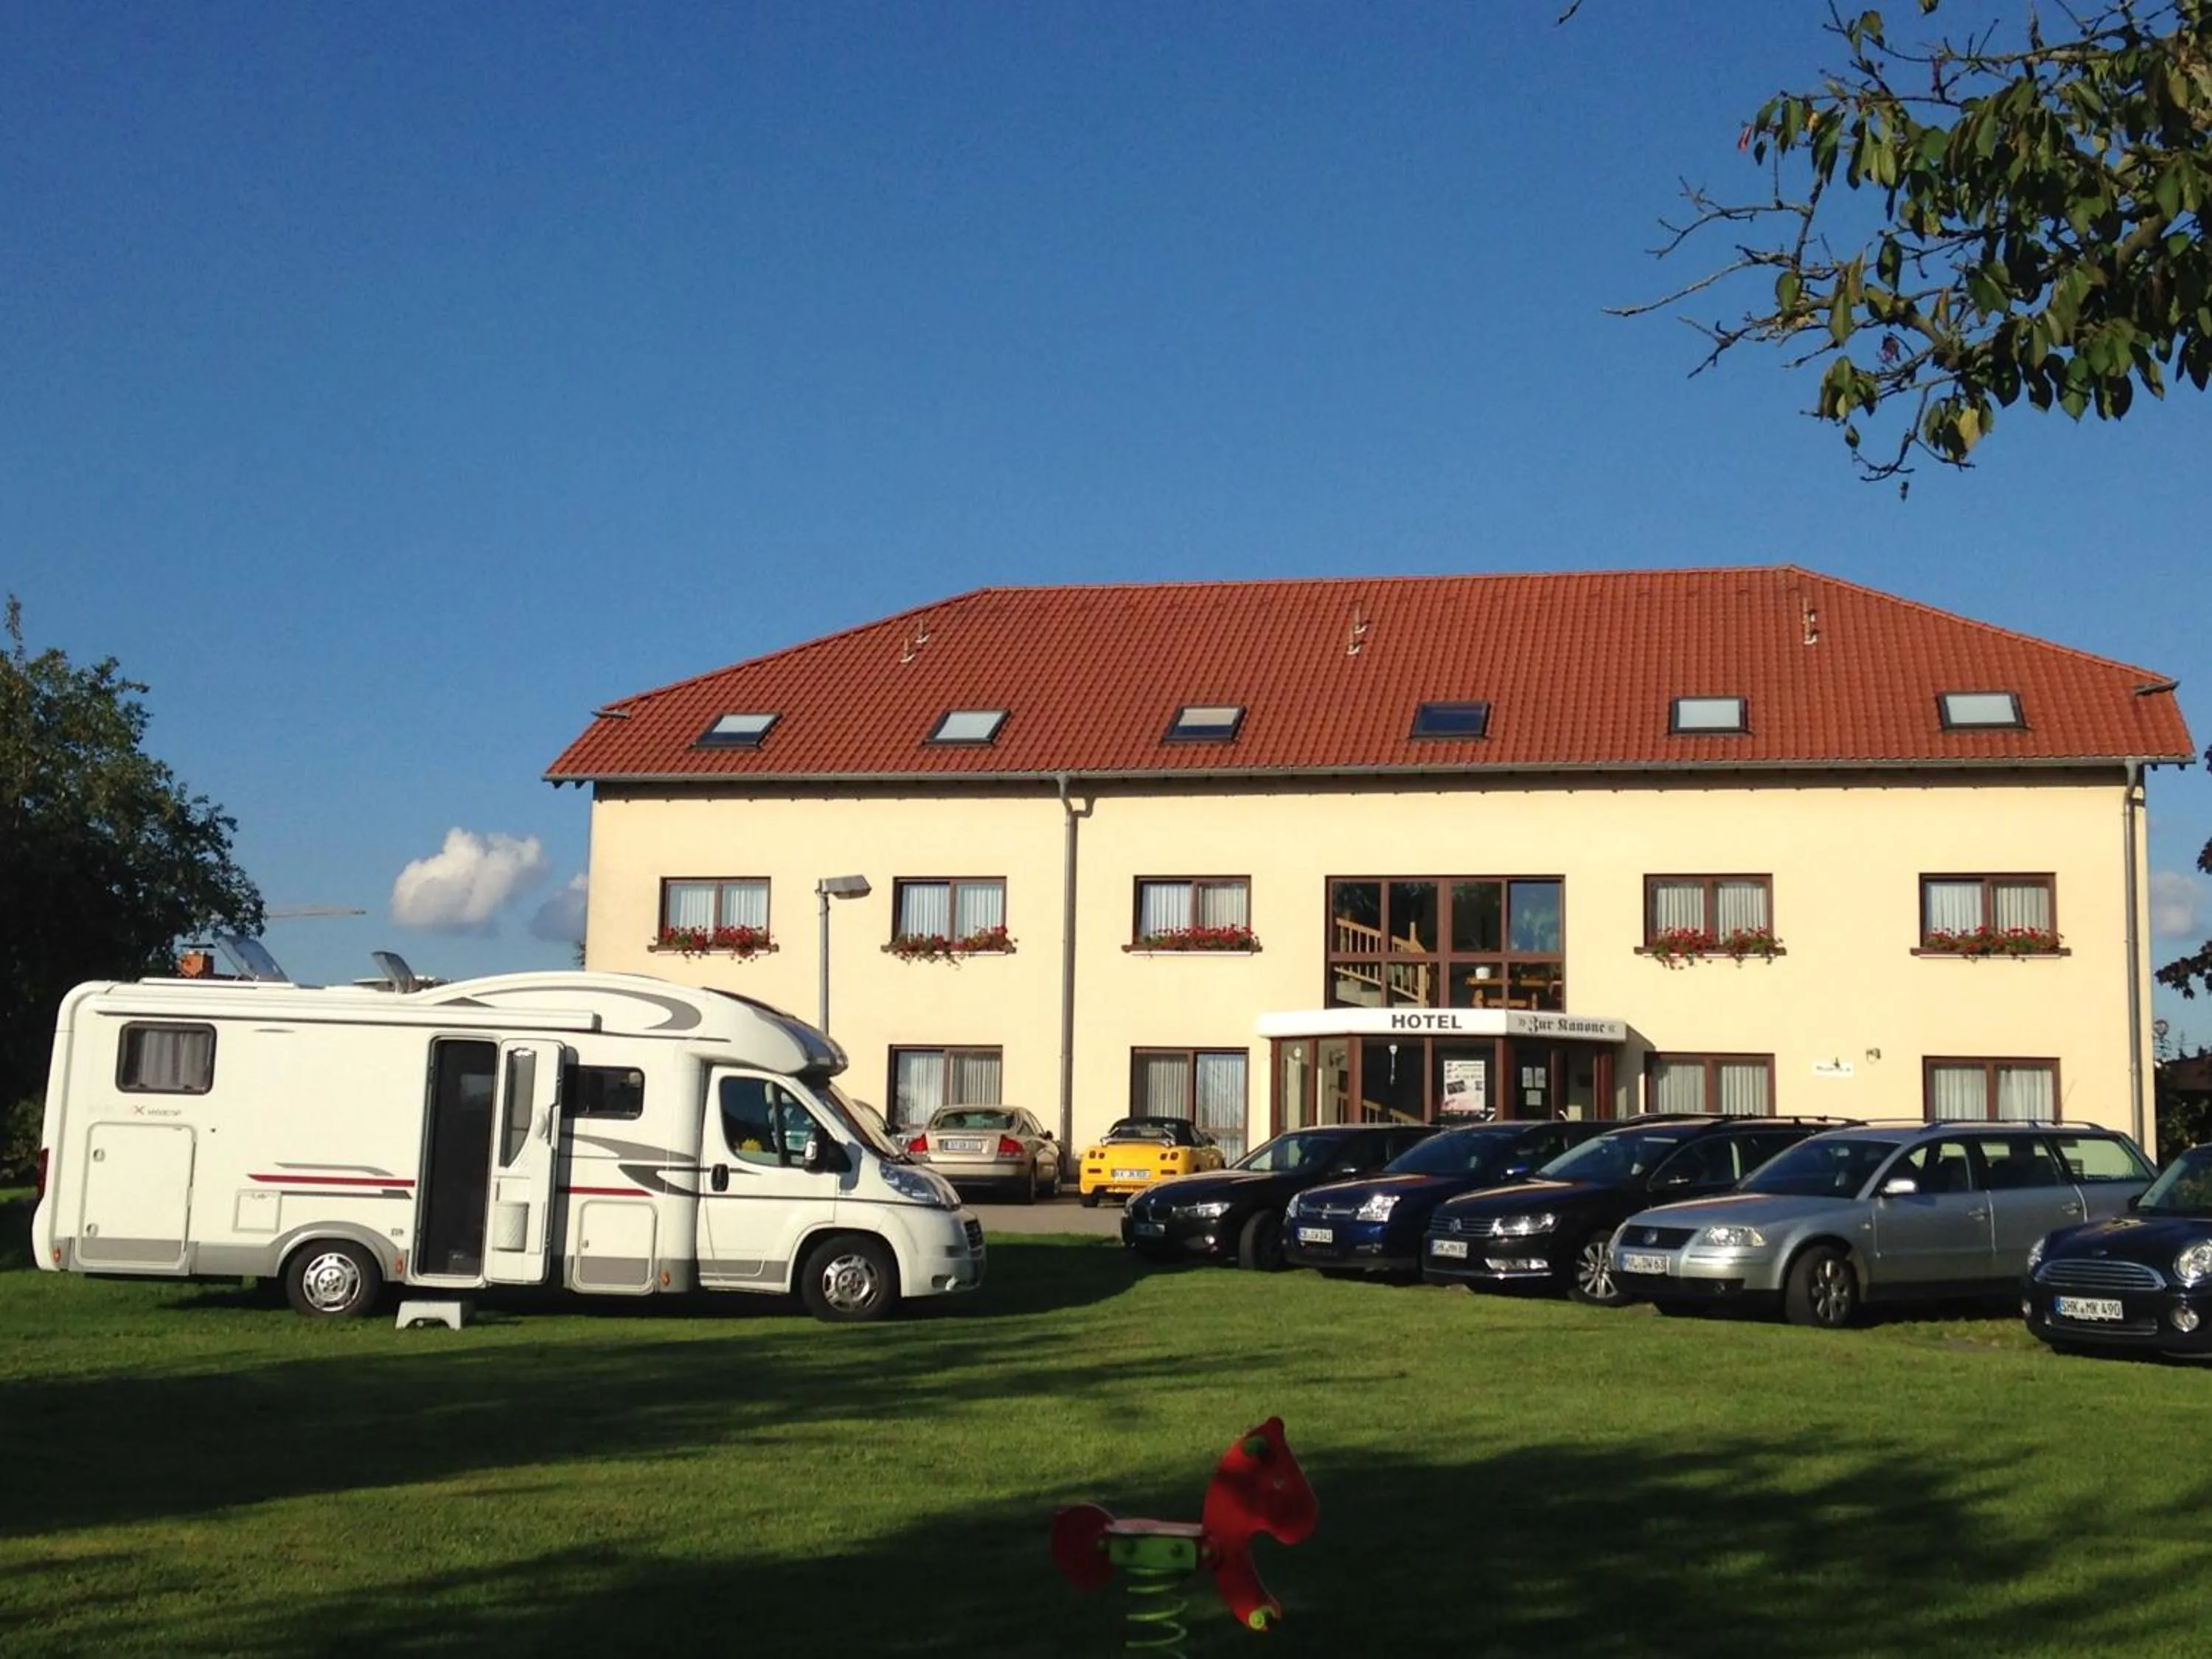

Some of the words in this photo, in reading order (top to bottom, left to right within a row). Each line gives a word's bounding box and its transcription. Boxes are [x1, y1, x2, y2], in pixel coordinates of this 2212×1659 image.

[1391, 1014, 1462, 1029] HOTEL
[1528, 1015, 1554, 1032] Zur
[1558, 1018, 1605, 1032] Kanone
[2062, 1300, 2078, 1313] SHK
[2101, 1303, 2121, 1316] 490
